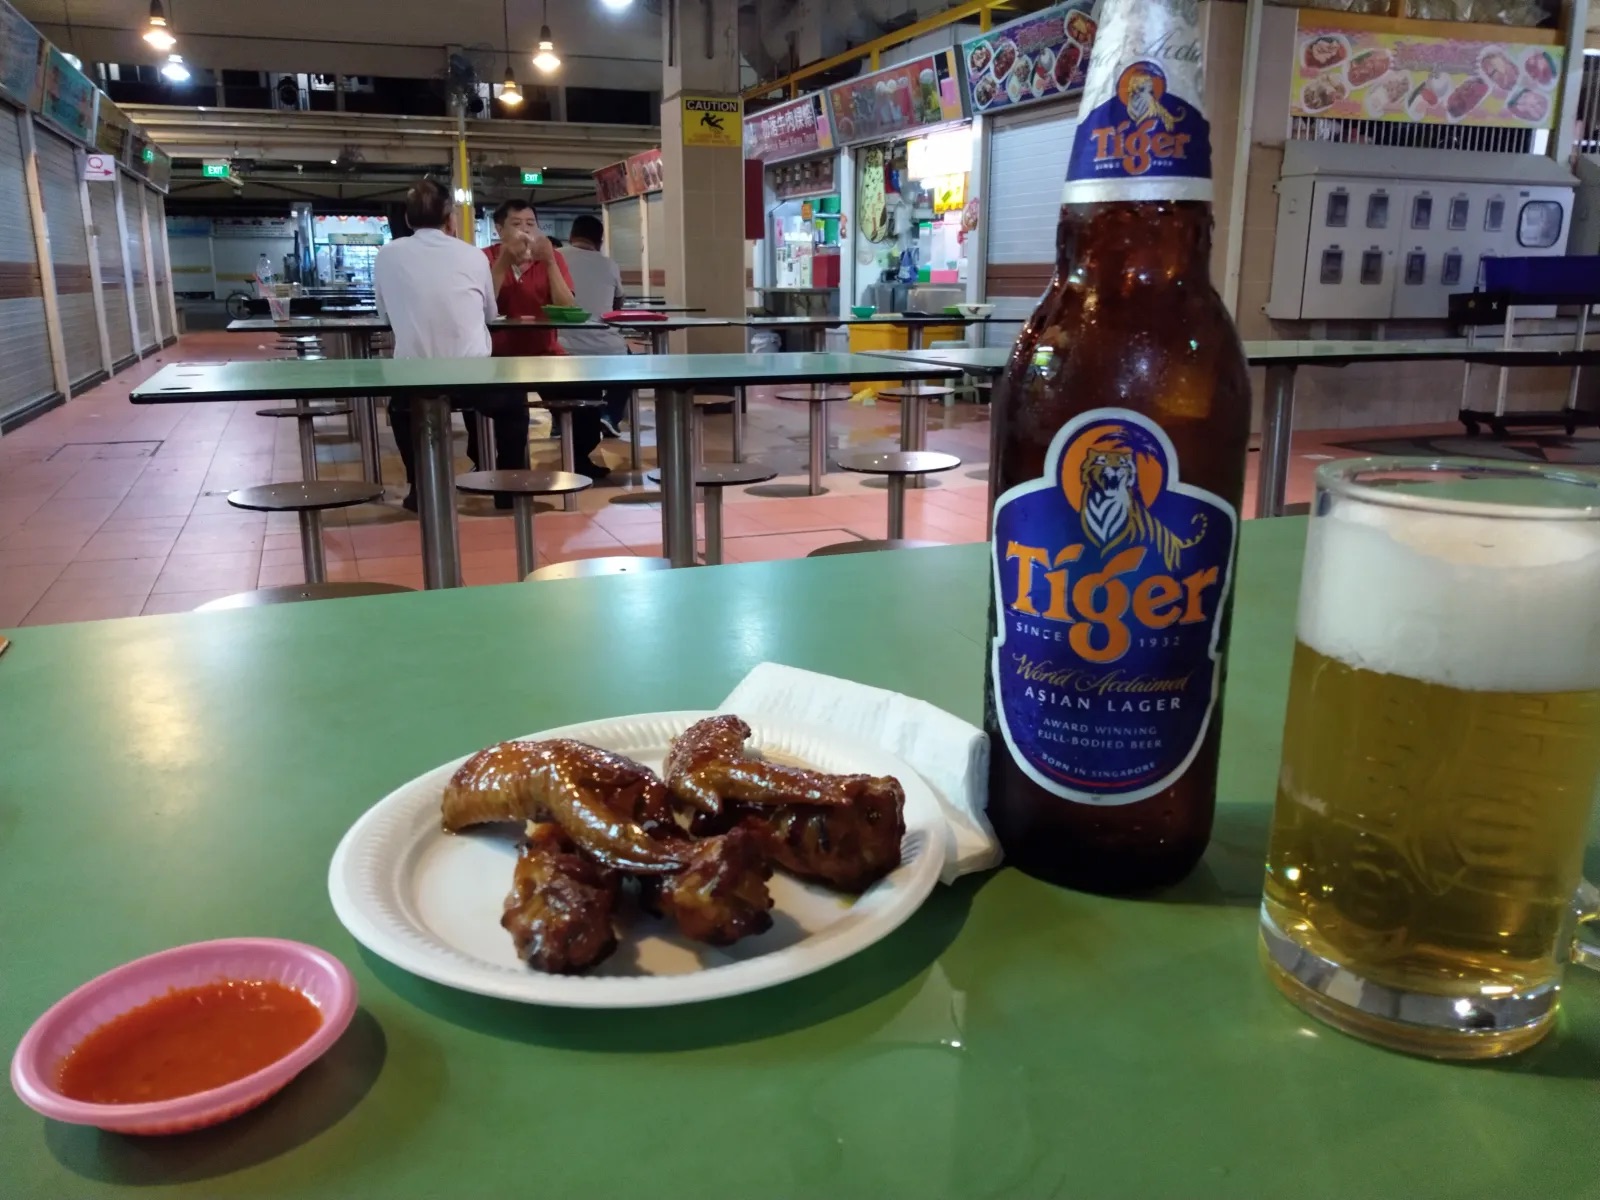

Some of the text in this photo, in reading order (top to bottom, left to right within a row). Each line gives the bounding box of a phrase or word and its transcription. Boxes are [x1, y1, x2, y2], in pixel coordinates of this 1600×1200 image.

[687, 100, 737, 112] CAUTION
[1090, 119, 1191, 175] Tiger
[88, 156, 103, 169] Q
[208, 166, 223, 175] EXIT
[525, 173, 538, 182] EXIT
[1006, 540, 1219, 664] Tiger
[1016, 622, 1180, 648] SINCE 1932
[1012, 652, 1193, 696] World Acclaimed
[1025, 686, 1181, 712] ASIAN LAGER
[1043, 718, 1157, 736] AWARD WINNING
[1038, 729, 1163, 749] FULL-BODIED BEER
[1041, 752, 1156, 778] BORN IN SINGAPORE
